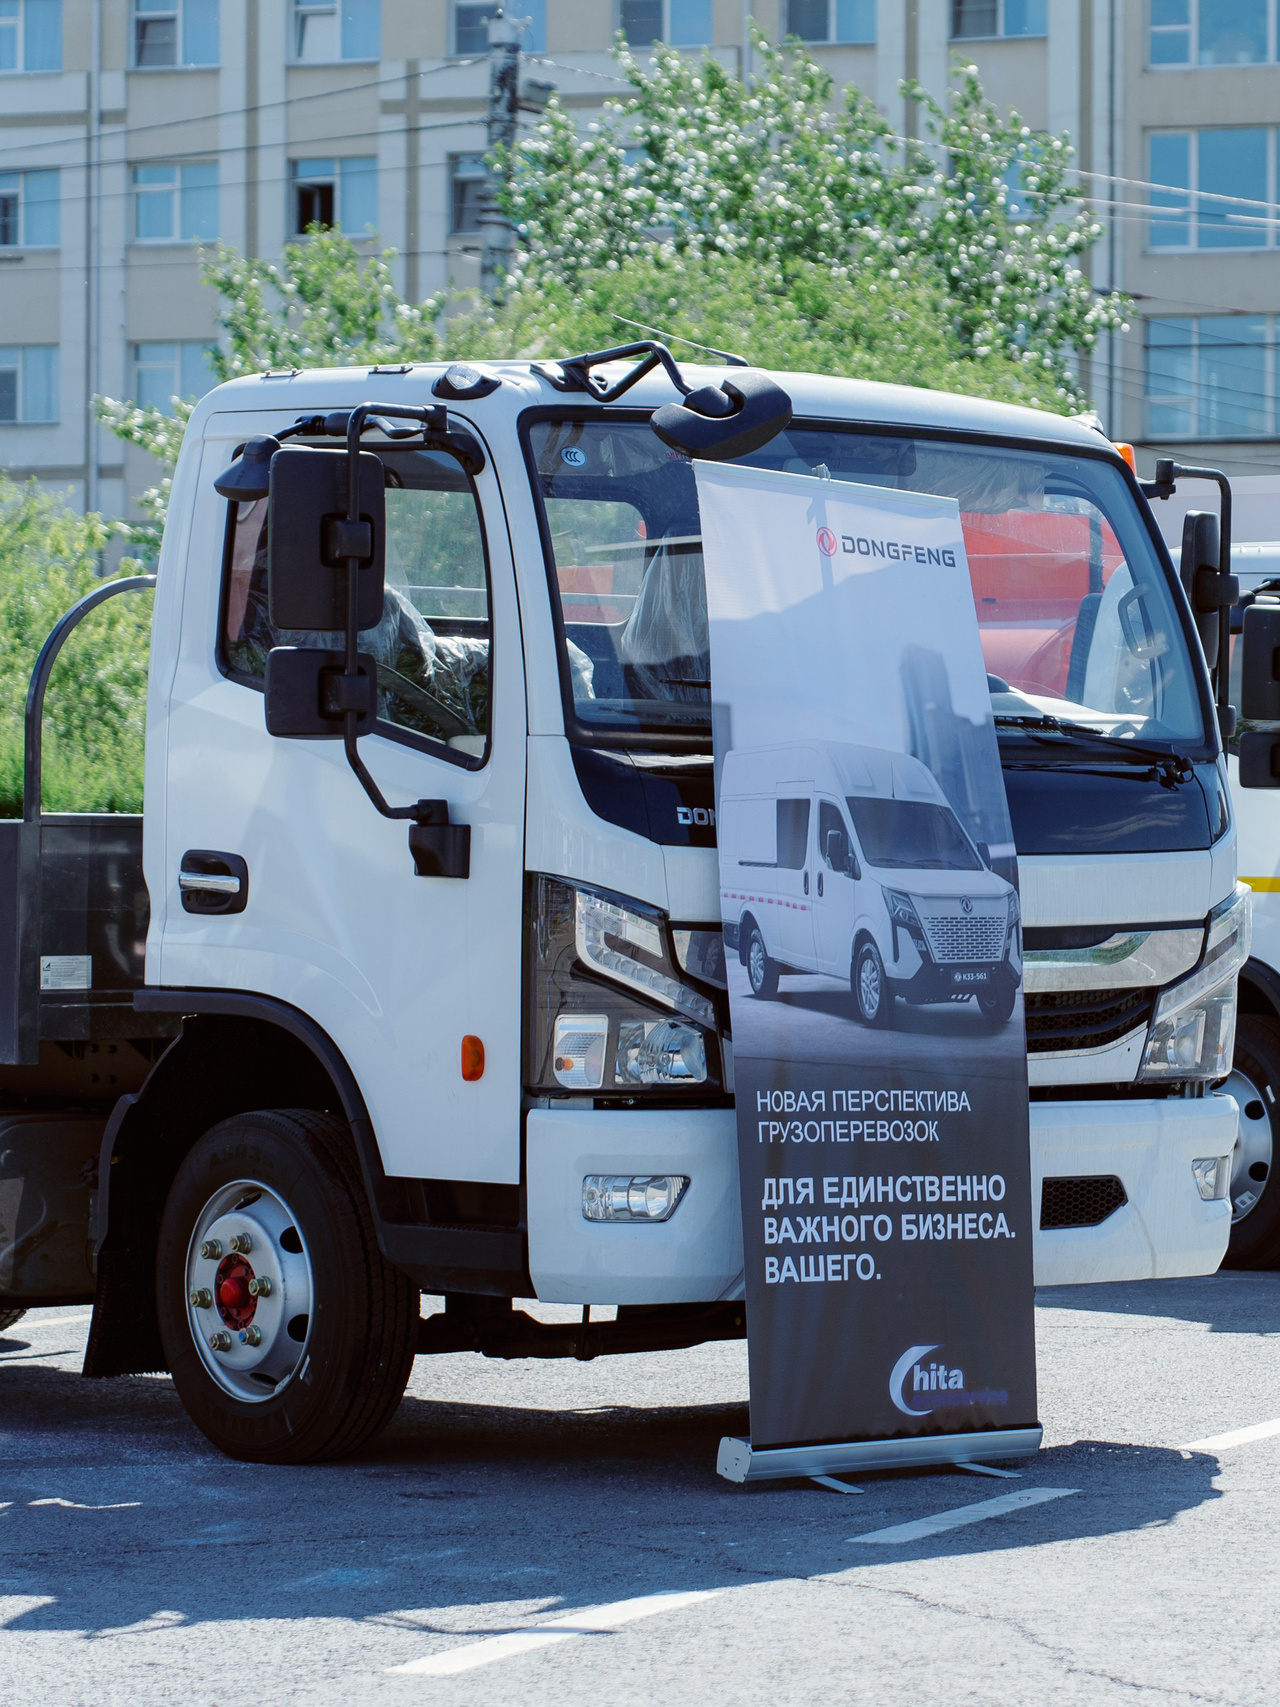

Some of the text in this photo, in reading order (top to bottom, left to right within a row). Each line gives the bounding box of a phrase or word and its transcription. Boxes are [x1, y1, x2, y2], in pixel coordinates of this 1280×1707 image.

[841, 534, 957, 568] DONGFENG
[756, 1090, 972, 1112] НОВАЯ ПЕРСПЕКТИВА
[758, 1120, 940, 1143] ГРУЗОПЕРЕВОЗОК
[761, 1174, 1007, 1210] ДЛЯ ЕДИНСТВЕННО
[764, 1212, 1017, 1244] ВАЖНОГО БИЗНЕСА.
[765, 1253, 882, 1284] ВАШЕГО.
